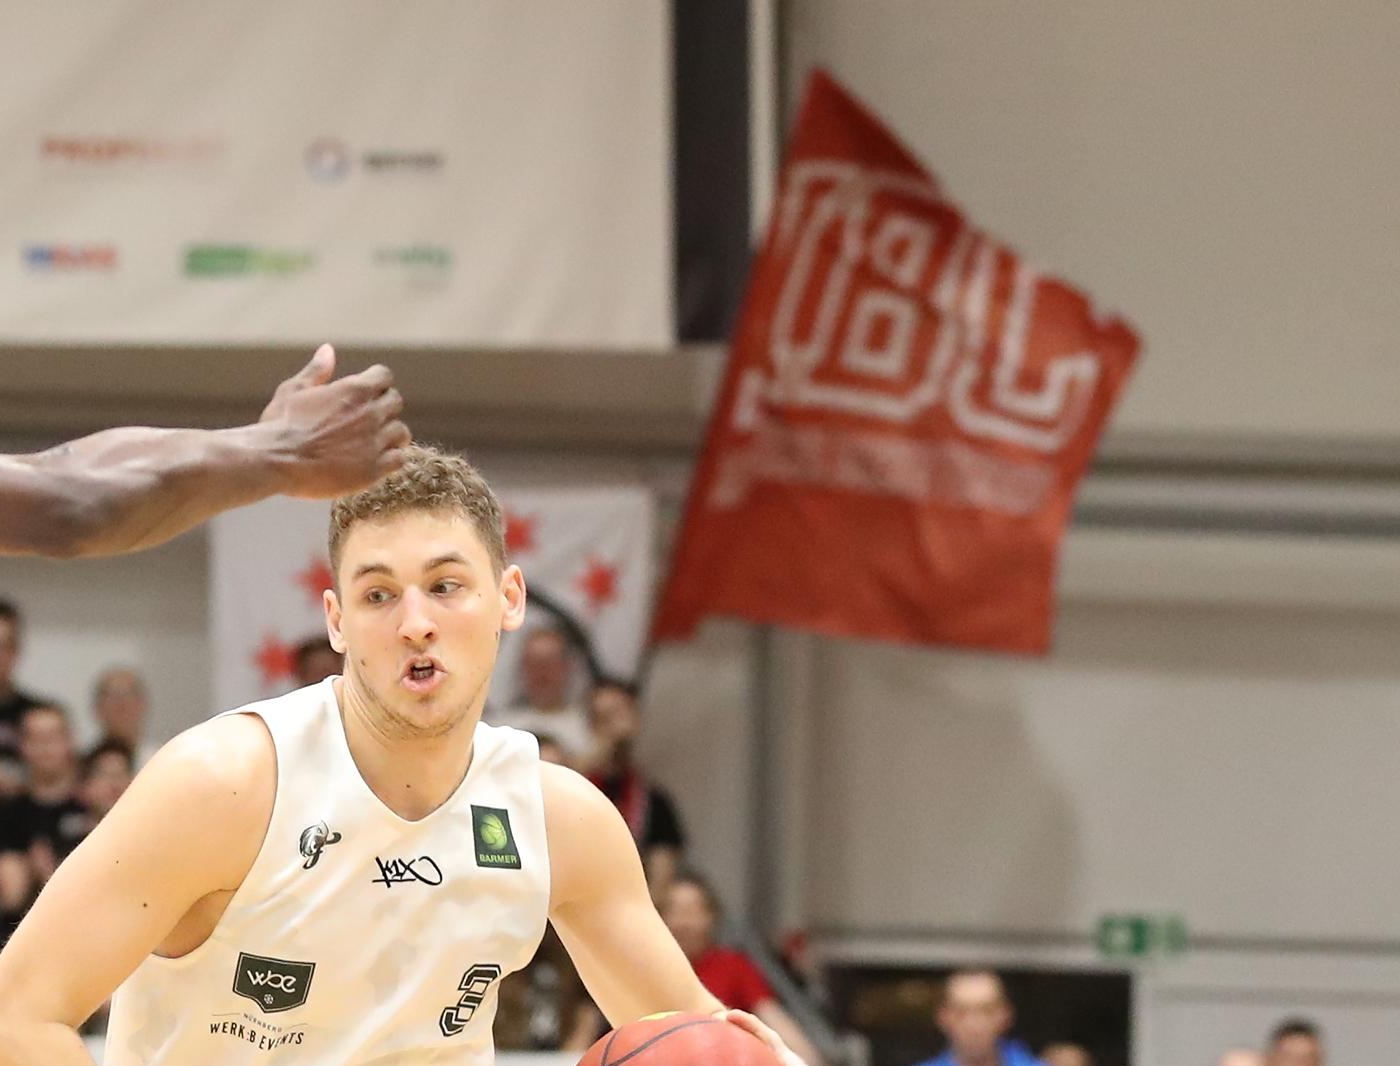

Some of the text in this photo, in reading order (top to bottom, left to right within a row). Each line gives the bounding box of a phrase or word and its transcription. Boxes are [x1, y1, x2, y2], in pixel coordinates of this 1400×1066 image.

[479, 854, 517, 864] BARMER
[439, 963, 502, 1037] 3
[258, 1031, 304, 1050] EVNTS
